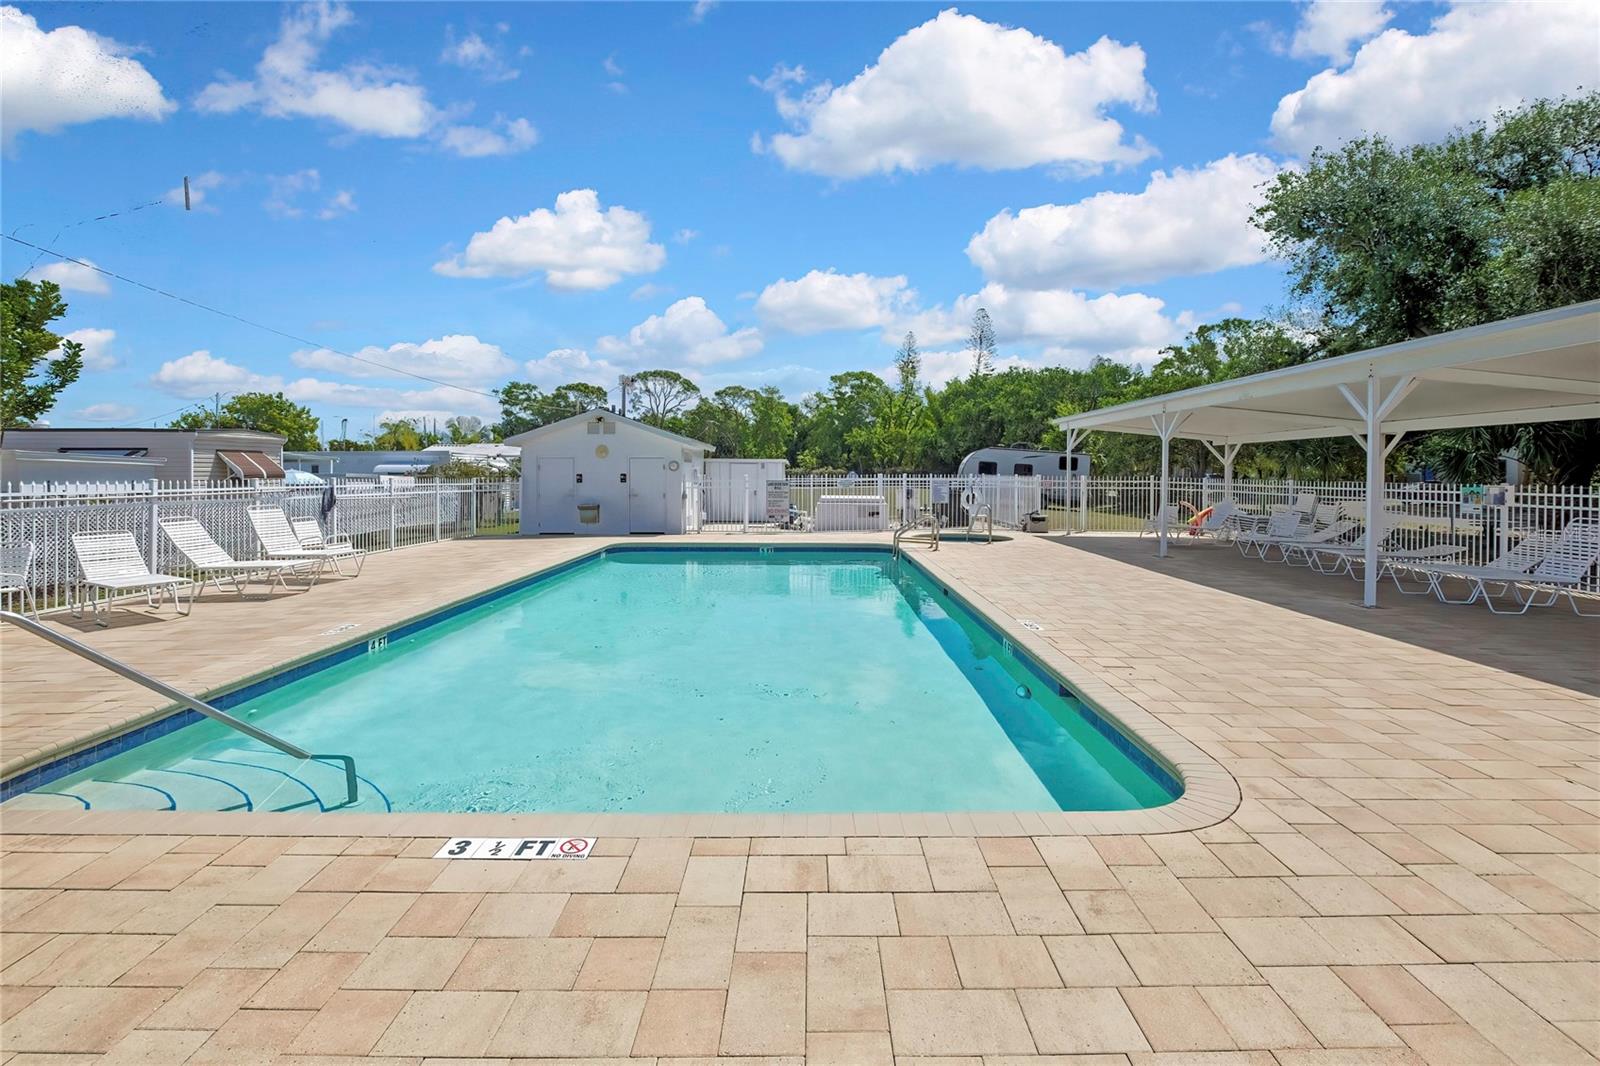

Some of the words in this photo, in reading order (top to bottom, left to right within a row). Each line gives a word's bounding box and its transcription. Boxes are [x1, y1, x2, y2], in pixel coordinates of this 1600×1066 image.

[370, 640, 376, 650] 4
[378, 636, 387, 647] FT
[447, 840, 472, 856] 3
[514, 840, 556, 856] FT
